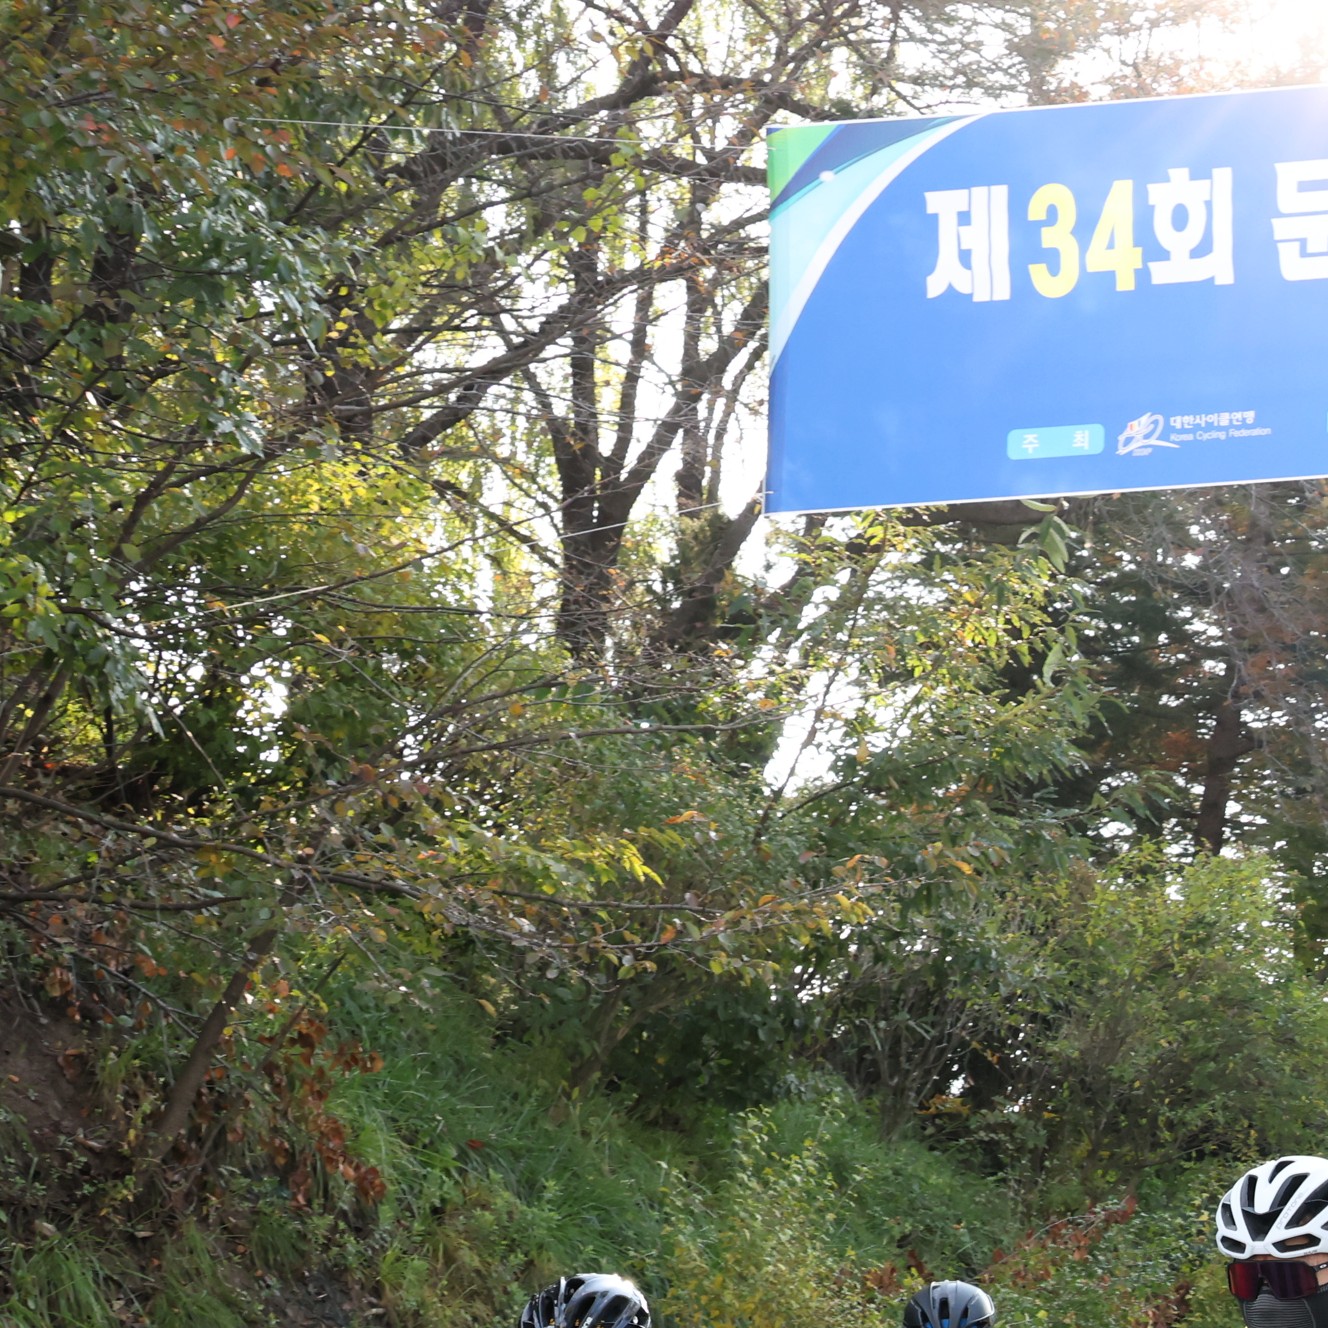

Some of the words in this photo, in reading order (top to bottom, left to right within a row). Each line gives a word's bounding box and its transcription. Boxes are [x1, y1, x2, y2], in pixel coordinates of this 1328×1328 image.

[924, 166, 1235, 303] 제34회
[1169, 410, 1257, 430] 대한사이클연맹
[1169, 430, 1195, 443] Korea
[1196, 429, 1227, 443] Cycling
[1228, 426, 1273, 438] Federation
